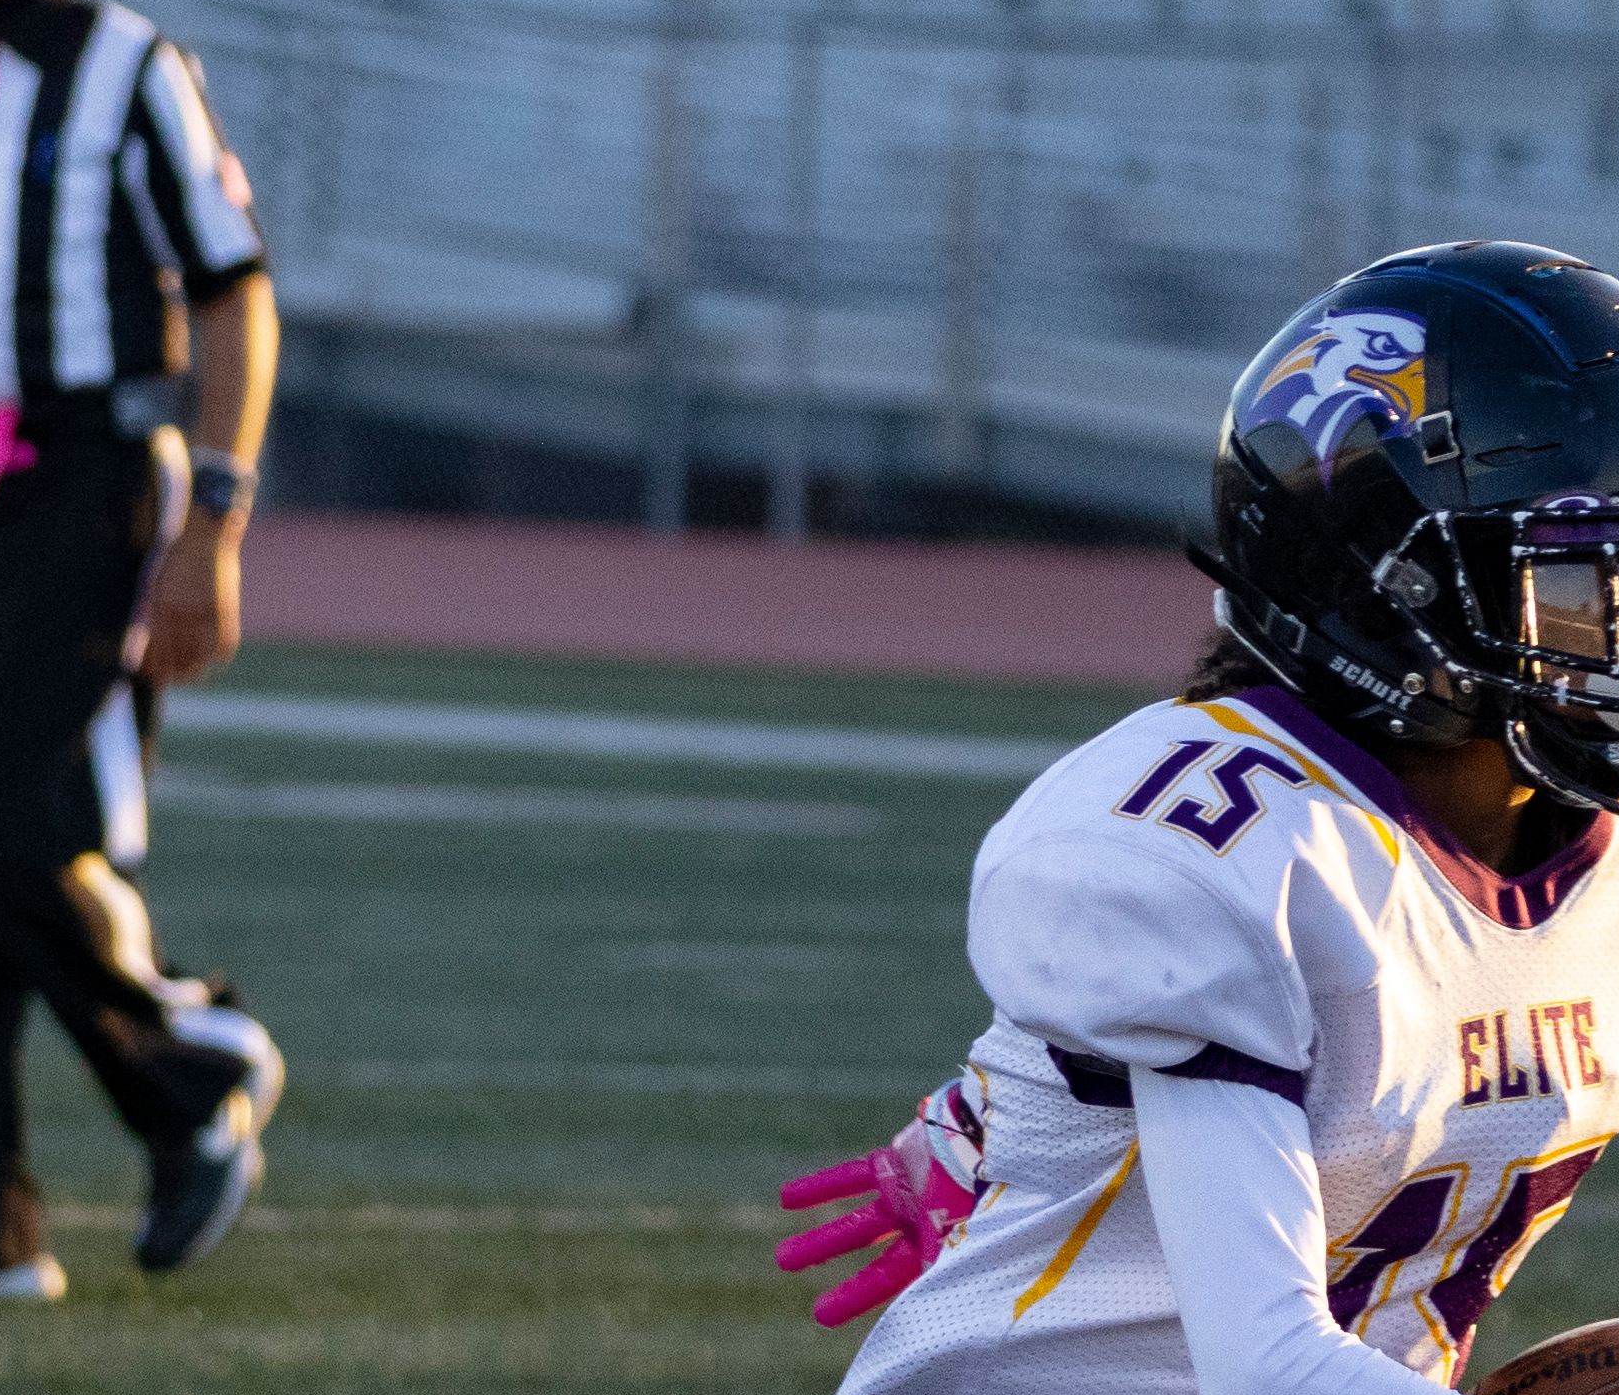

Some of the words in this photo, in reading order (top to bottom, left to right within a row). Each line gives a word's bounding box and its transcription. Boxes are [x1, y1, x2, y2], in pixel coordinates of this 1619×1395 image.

[1329, 654, 1413, 711] schutt
[1111, 738, 1316, 857] 15
[1459, 996, 1603, 1110] ELITE
